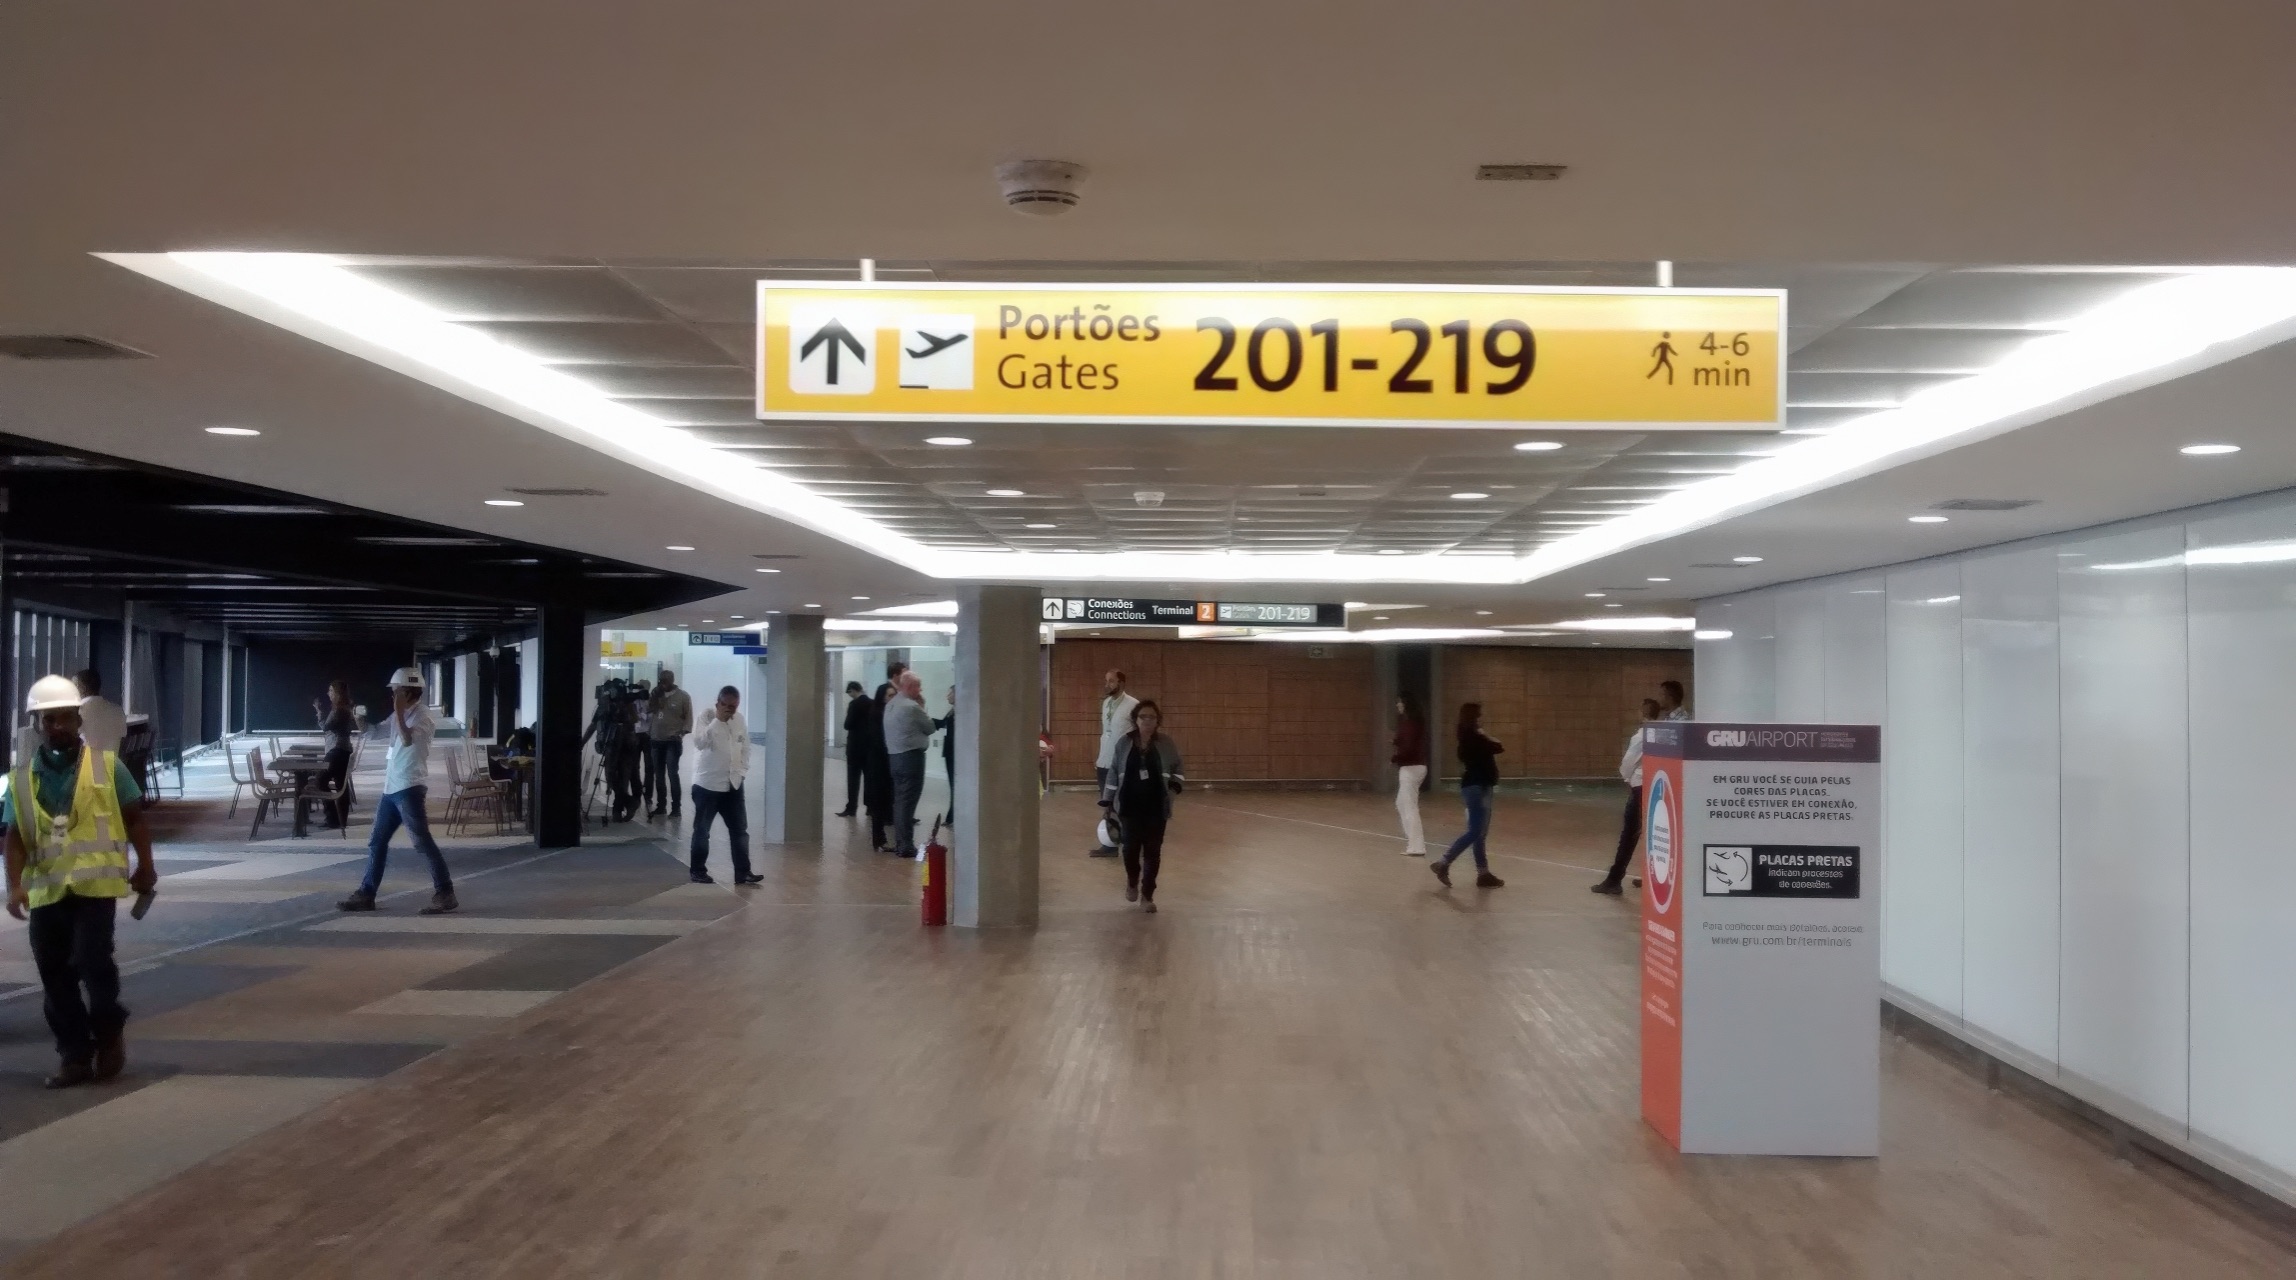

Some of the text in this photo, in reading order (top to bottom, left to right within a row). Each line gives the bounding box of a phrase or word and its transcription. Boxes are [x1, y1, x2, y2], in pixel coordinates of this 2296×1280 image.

[999, 304, 1161, 342] Portões
[1699, 332, 1750, 357] 4-6
[1194, 317, 1537, 395] 201-219
[997, 353, 1119, 390] Gates
[1693, 360, 1750, 387] min
[1087, 598, 1134, 609] Conexões
[1087, 609, 1147, 620] Connections
[1151, 604, 1211, 619] Terminal 2
[1257, 606, 1311, 620] 201-219
[1713, 774, 1851, 785] EM GRU VOCÊ SE GUIA PELAS
[1734, 787, 1765, 795] CORES
[1768, 788, 1787, 796] DAS
[1706, 799, 1718, 807] SE
[1721, 797, 1745, 807] VOCÊ
[1748, 799, 1789, 808] ESTIVER
[1791, 799, 1805, 808] EM
[1709, 810, 1755, 819] PROCURE
[1758, 811, 1771, 819] AS
[1773, 811, 1810, 820] PLACAS
[1758, 854, 1853, 867] PLACAS PRETAS
